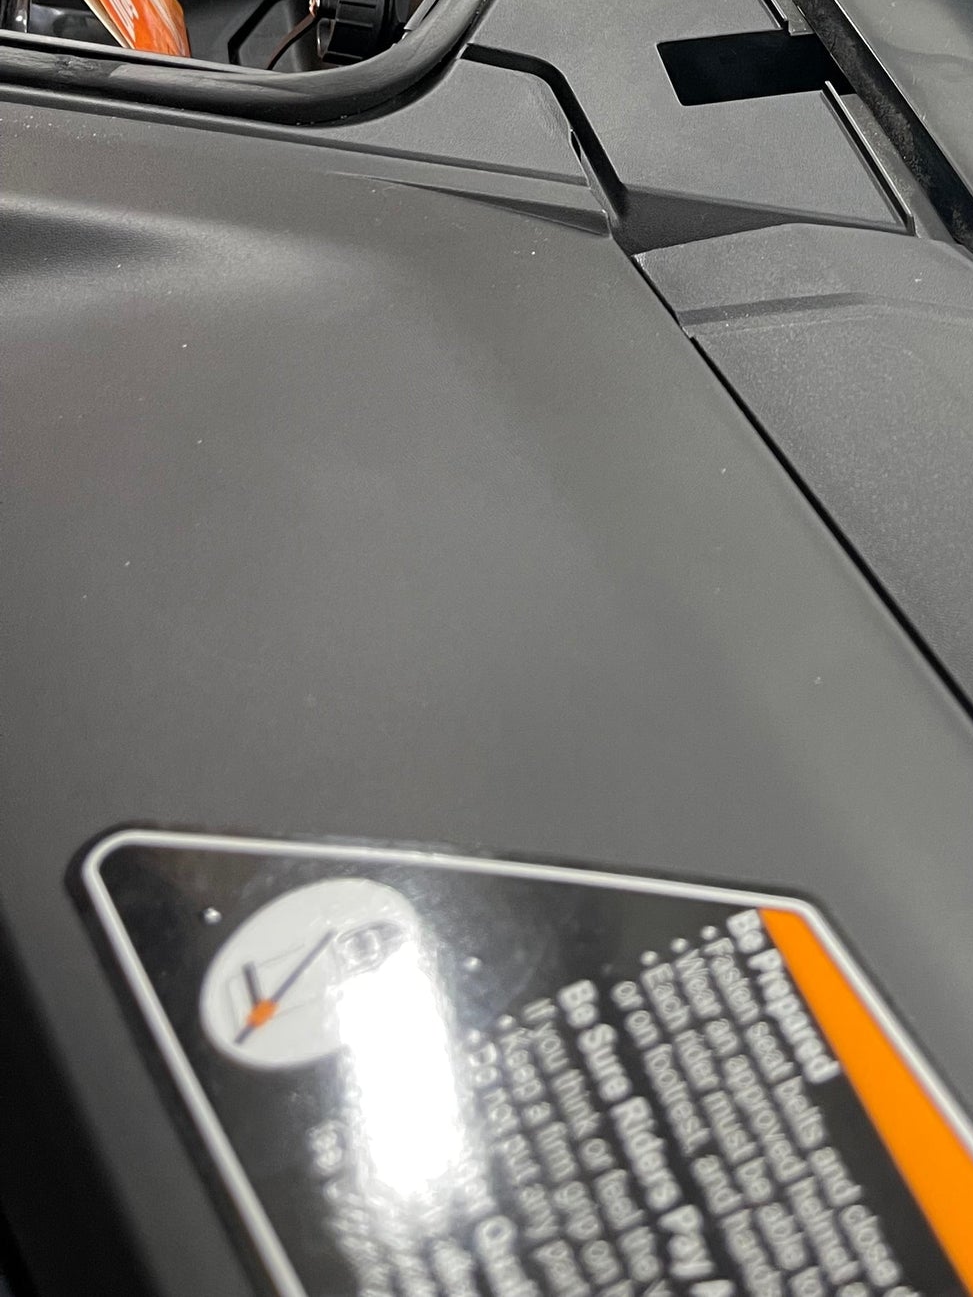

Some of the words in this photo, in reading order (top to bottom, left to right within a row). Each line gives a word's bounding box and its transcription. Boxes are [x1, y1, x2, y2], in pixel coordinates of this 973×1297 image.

[557, 979, 598, 1028] Be
[612, 980, 644, 1010] or
[626, 1009, 660, 1049] on
[726, 908, 764, 953] Be
[747, 948, 840, 1084] Prepared
[526, 1020, 570, 1073] you
[577, 1022, 631, 1102] Sure
[641, 963, 690, 1031] Each
[675, 1028, 721, 1090] rider
[702, 1089, 756, 1164] must
[735, 1156, 773, 1204] be
[755, 1202, 806, 1272] able
[672, 949, 722, 1019] Wear
[706, 1018, 739, 1056] an
[723, 1054, 808, 1183] approved
[785, 1176, 858, 1285] helmet
[703, 938, 761, 1025] Fasten
[746, 1021, 793, 1082] seat
[774, 1076, 824, 1149] belts
[807, 1146, 861, 1207] and
[840, 1204, 899, 1288] close
[610, 1096, 682, 1210] Riders
[692, 1153, 742, 1215] and
[658, 1203, 716, 1280] Pay
